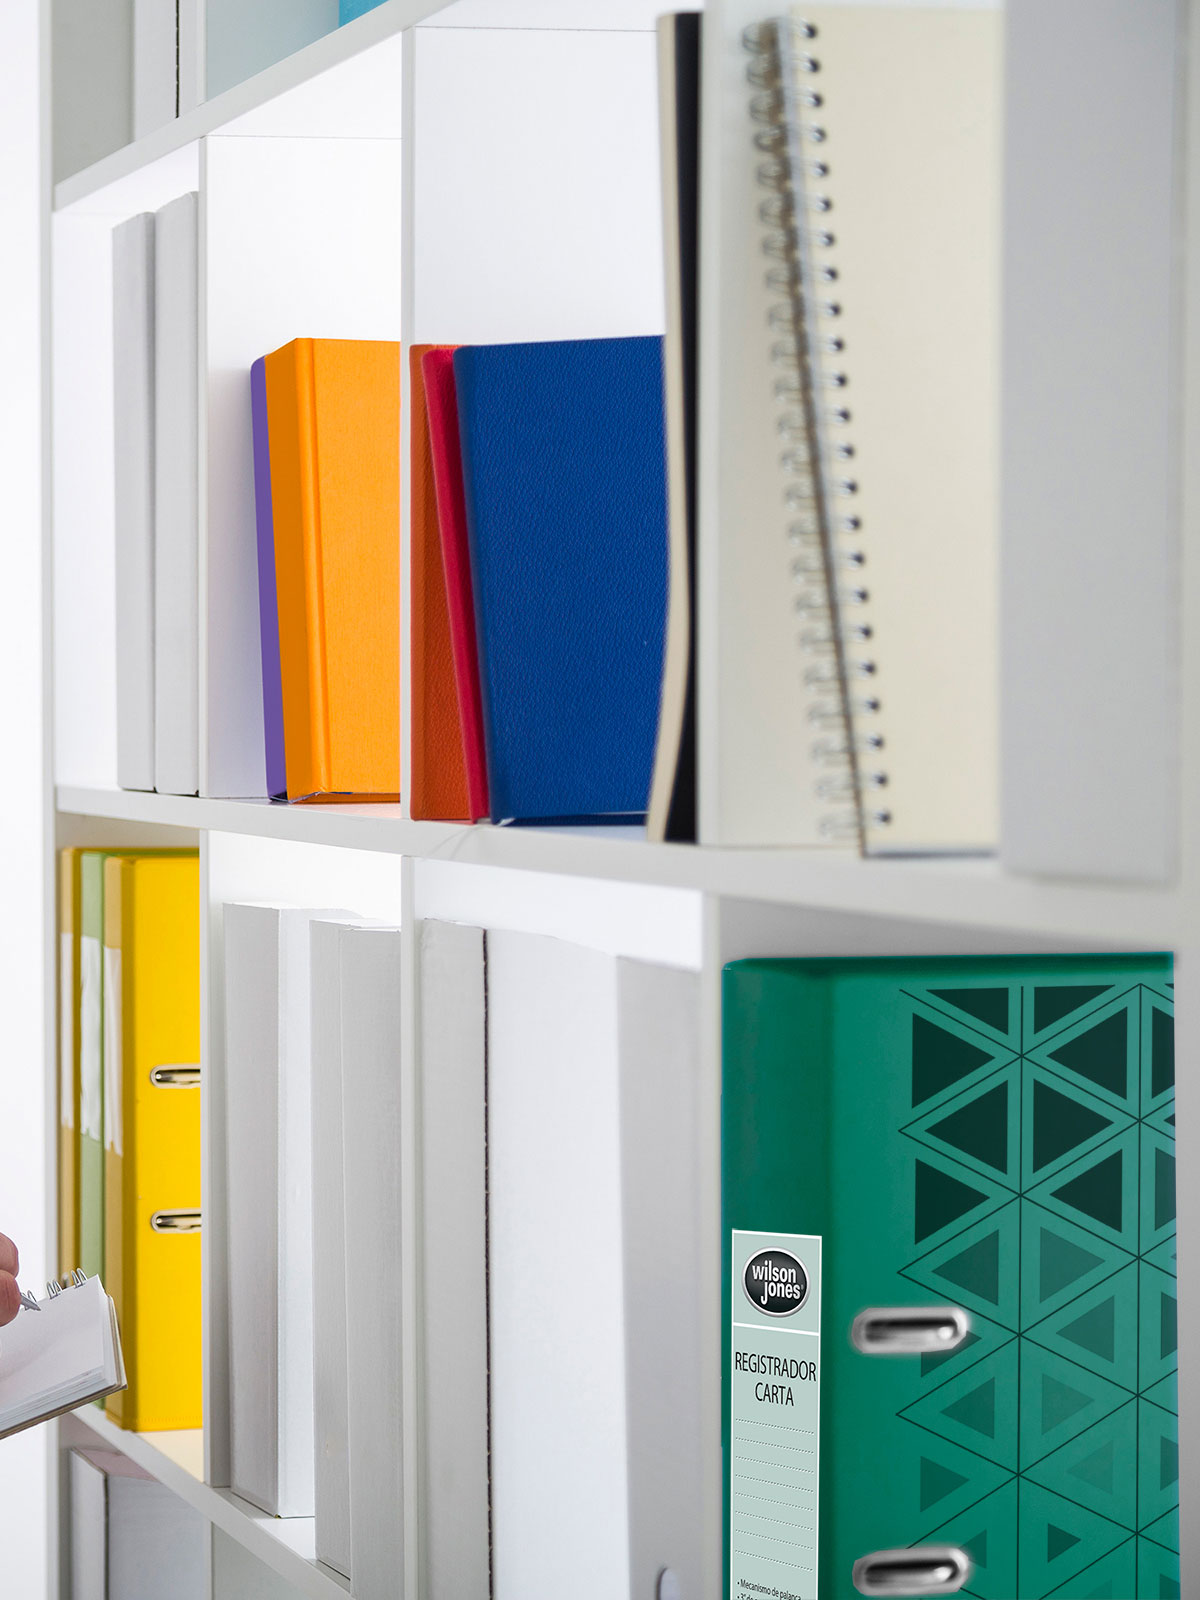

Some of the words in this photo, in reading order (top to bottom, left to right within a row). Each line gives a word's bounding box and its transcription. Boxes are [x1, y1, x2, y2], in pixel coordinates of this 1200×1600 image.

[752, 1261, 796, 1283] wilson
[760, 1280, 801, 1305] jones
[735, 1352, 817, 1382] REGISTRADOR
[755, 1383, 794, 1407] CARTA
[740, 1579, 771, 1595] Mecanismo
[772, 1587, 779, 1598] de
